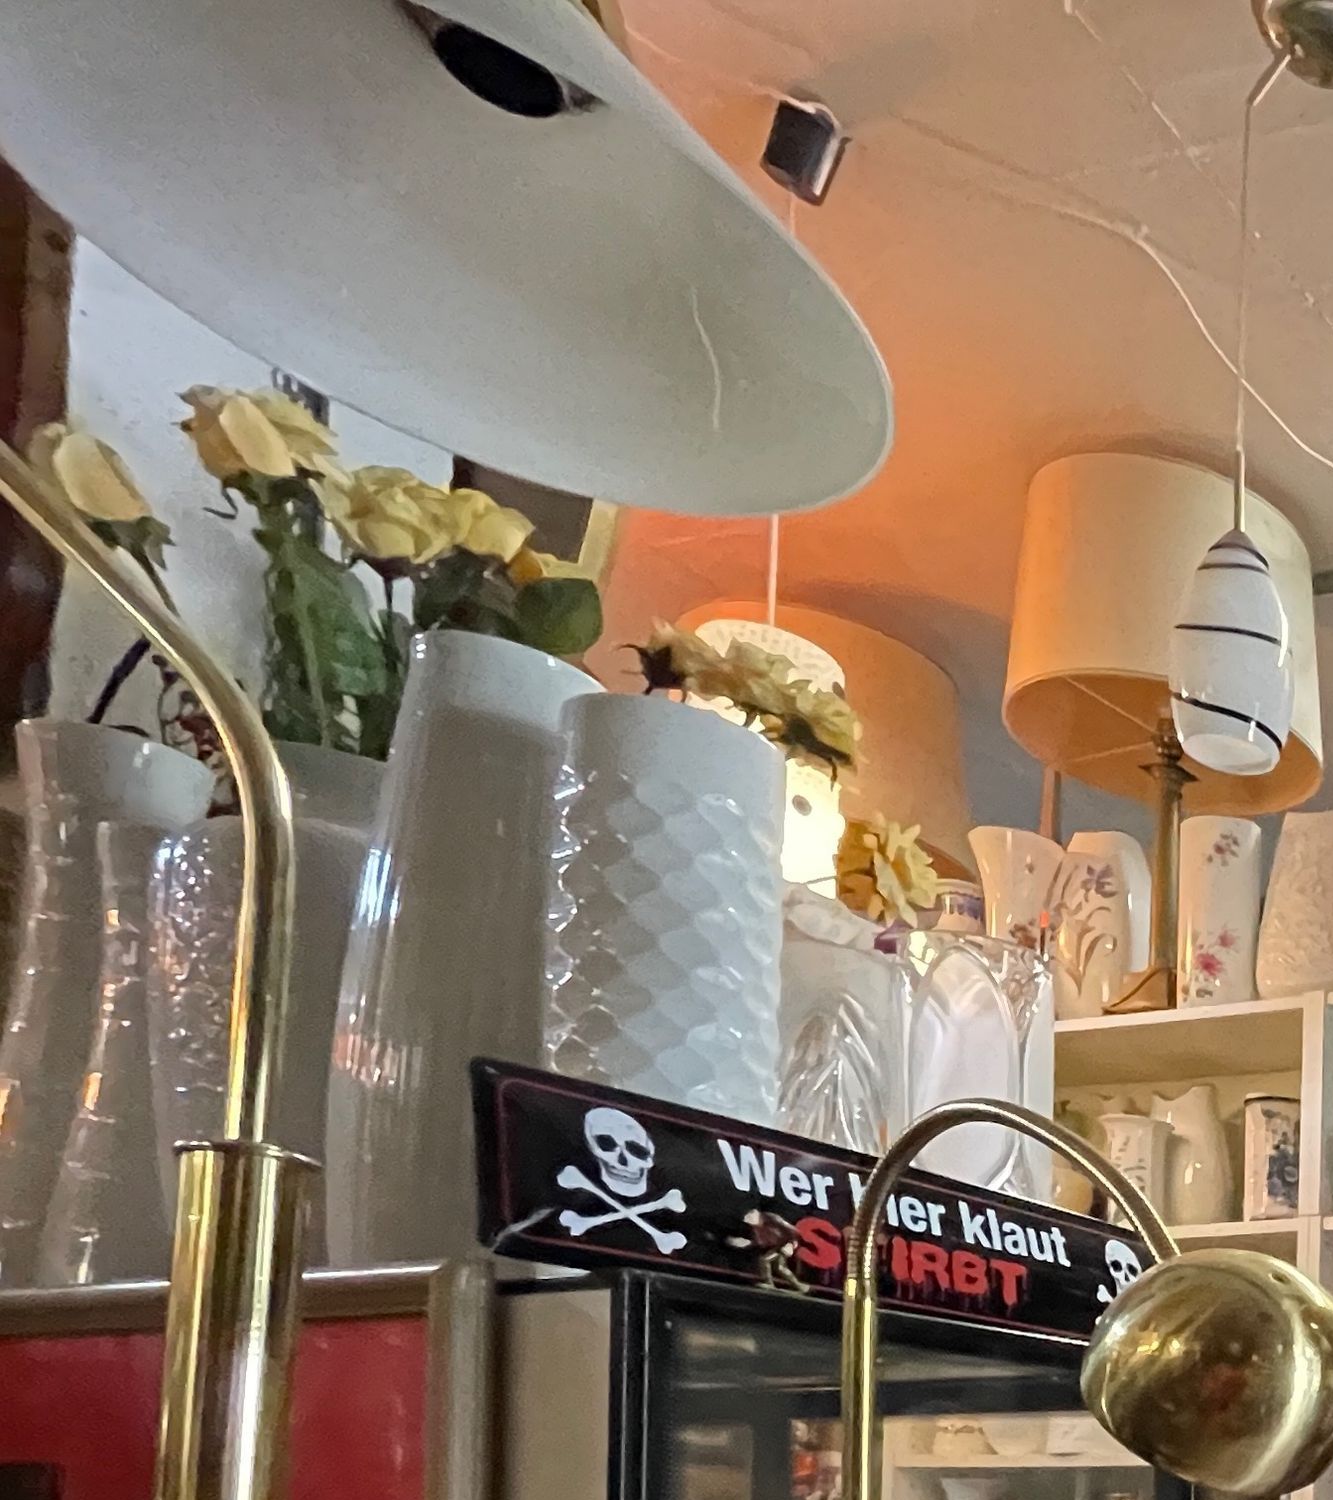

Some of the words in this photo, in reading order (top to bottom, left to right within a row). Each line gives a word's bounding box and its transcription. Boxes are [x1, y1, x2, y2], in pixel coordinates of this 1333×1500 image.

[717, 1138, 835, 1211] Wer
[958, 1200, 1072, 1268] klaut
[794, 1216, 1028, 1306] SIRBT
